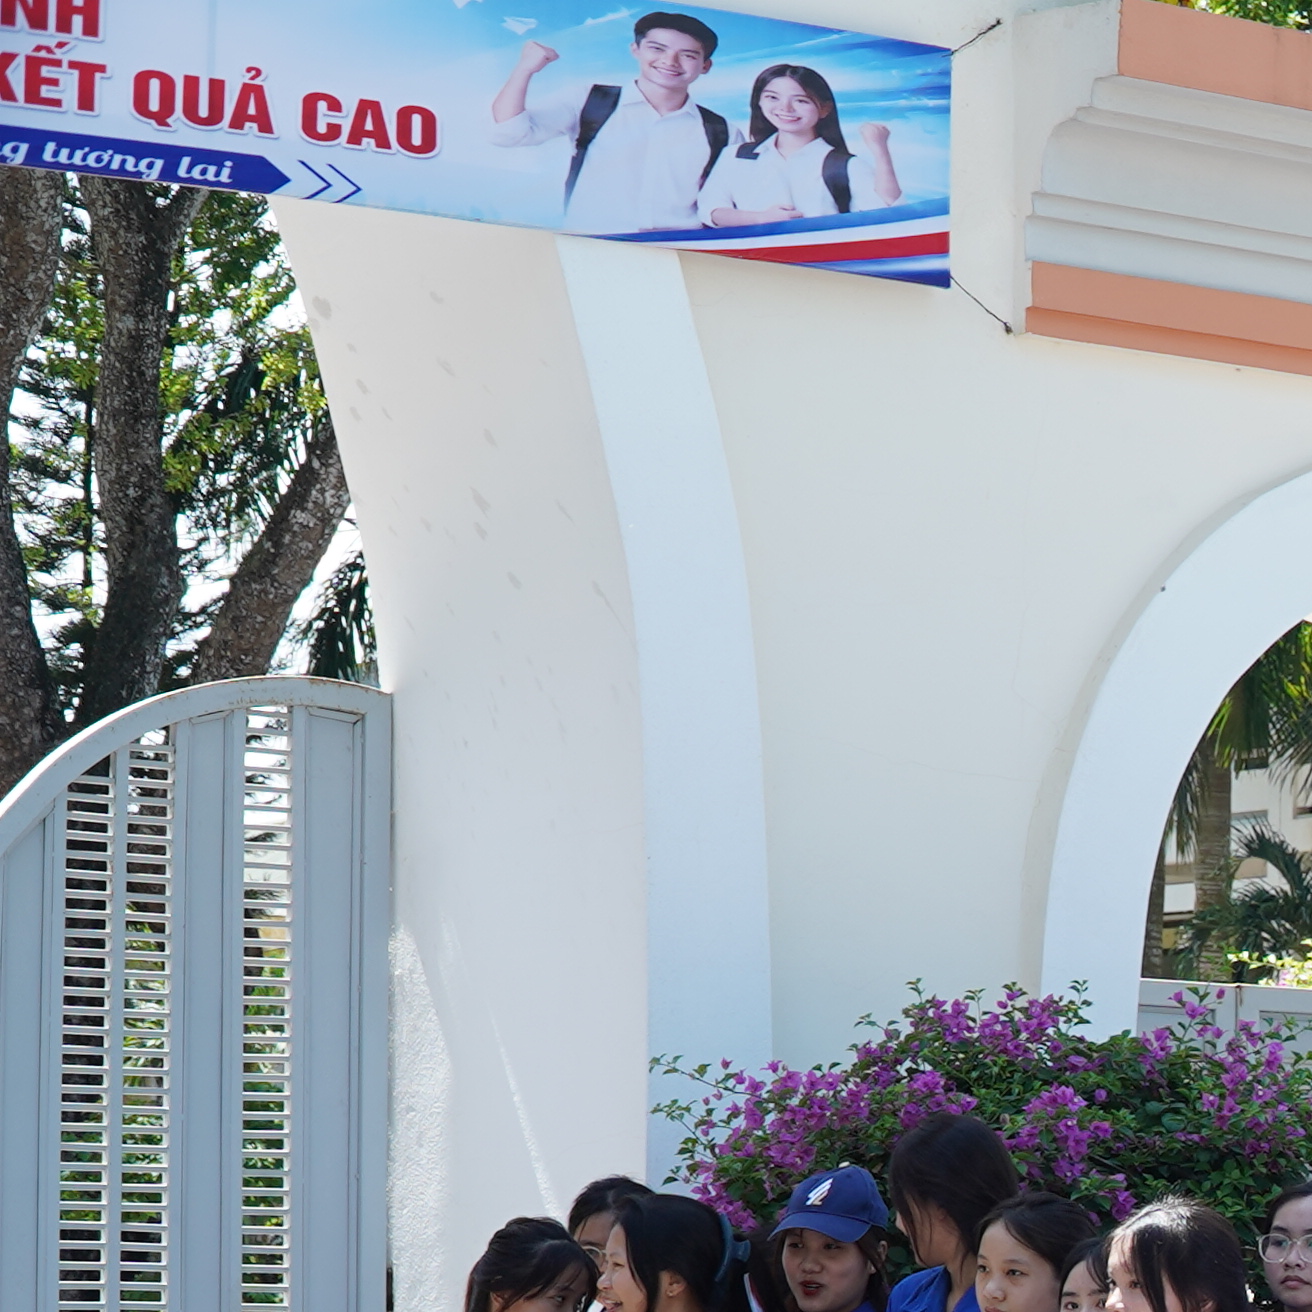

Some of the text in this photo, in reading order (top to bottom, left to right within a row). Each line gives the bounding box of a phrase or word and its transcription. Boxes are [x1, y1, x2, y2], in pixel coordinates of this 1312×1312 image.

[132, 66, 273, 136] QUẢ
[300, 92, 437, 155] CAO
[42, 141, 164, 180] tương
[177, 156, 233, 183] lai
